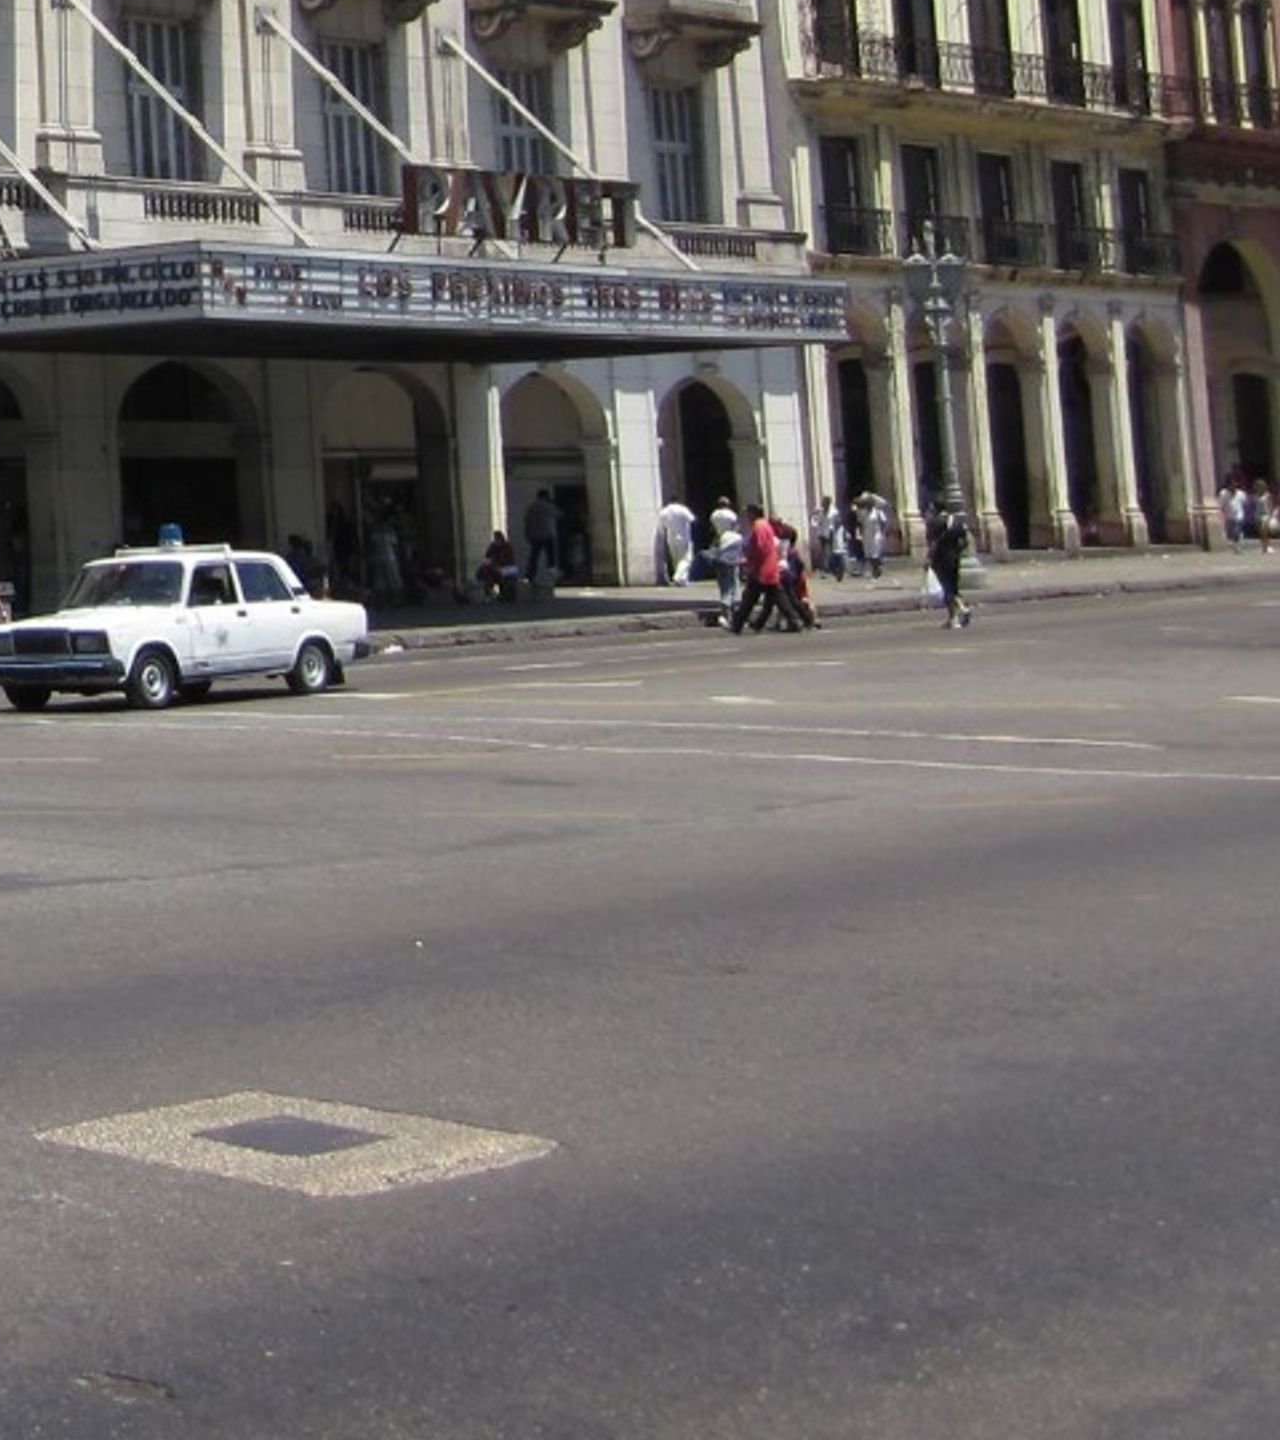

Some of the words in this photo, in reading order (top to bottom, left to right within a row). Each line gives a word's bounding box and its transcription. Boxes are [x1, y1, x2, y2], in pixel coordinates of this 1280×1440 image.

[402, 165, 640, 248] PAYRET
[12, 271, 49, 292] LAS
[140, 261, 196, 281] CICLO
[358, 267, 412, 301] LOS
